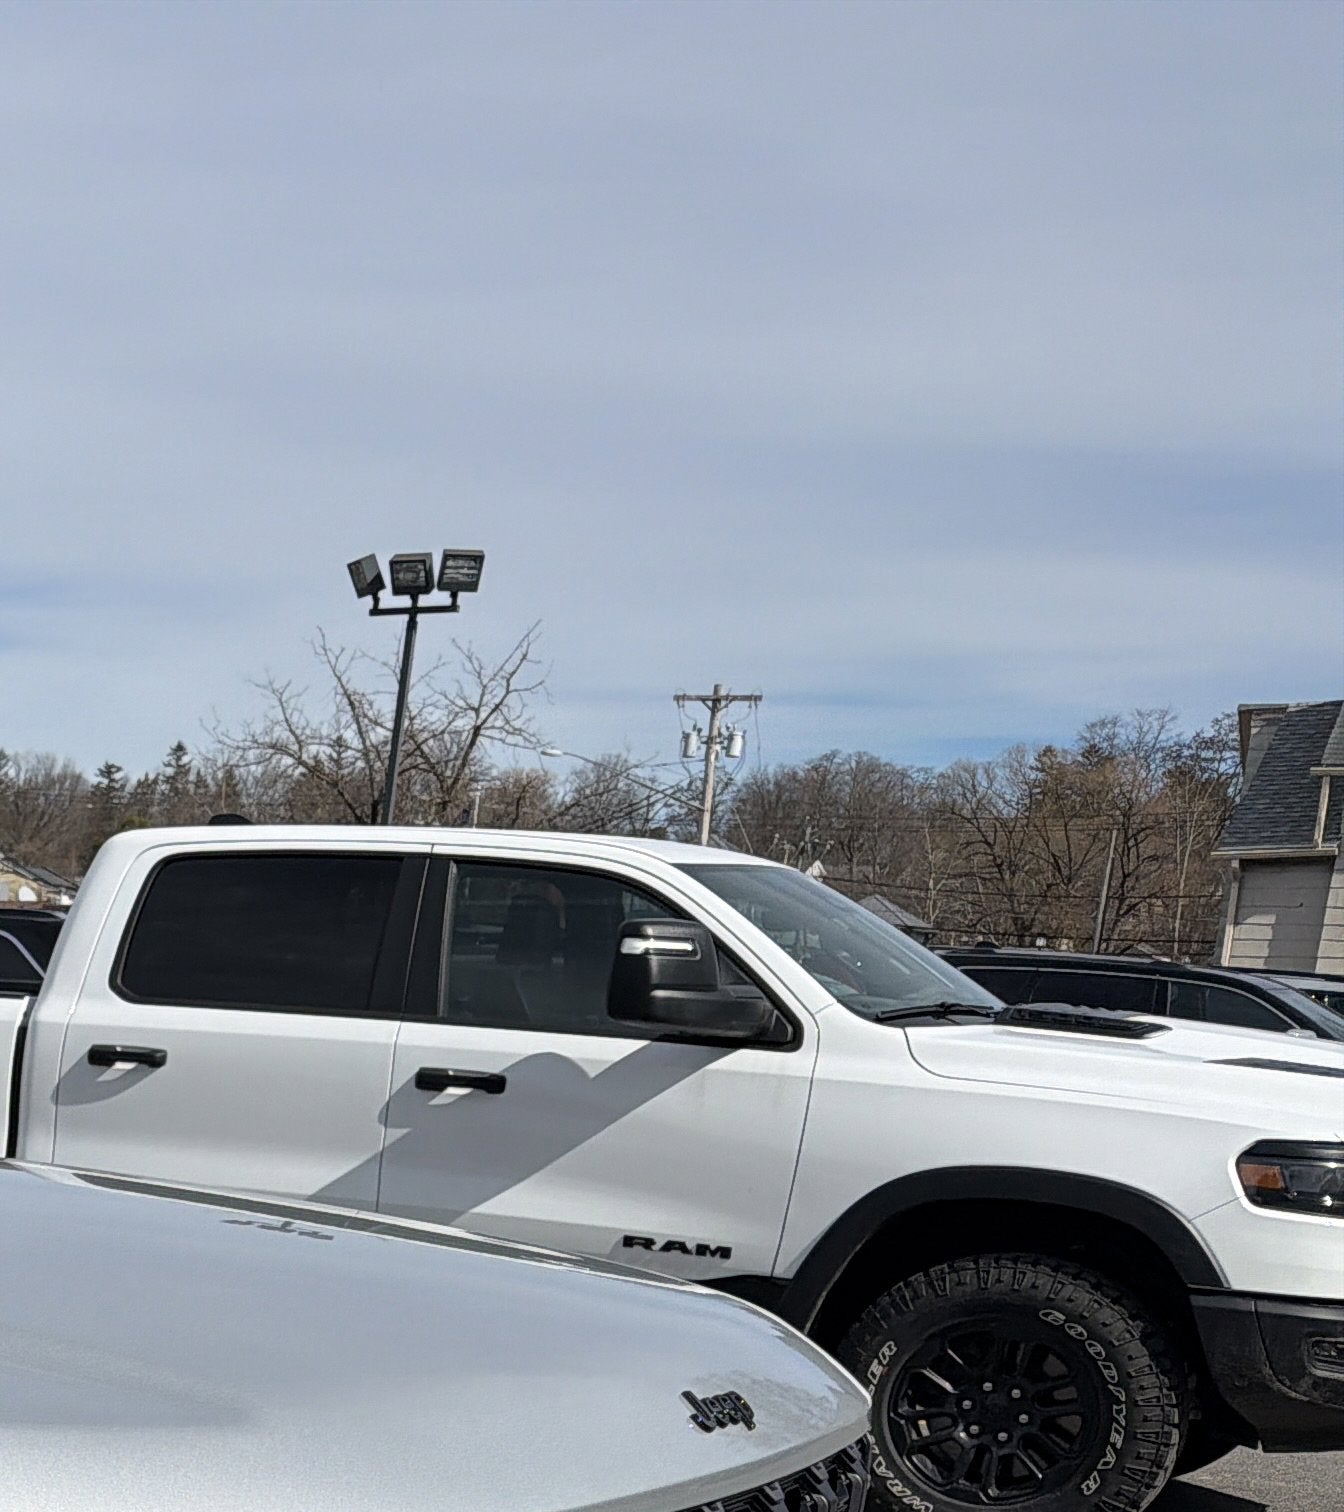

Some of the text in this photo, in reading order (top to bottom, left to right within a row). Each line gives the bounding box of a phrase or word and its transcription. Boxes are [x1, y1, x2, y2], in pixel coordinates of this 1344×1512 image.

[622, 1234, 733, 1259] RAM
[679, 1390, 757, 1433] Jeep
[1039, 1309, 1127, 1497] GOODYEAR
